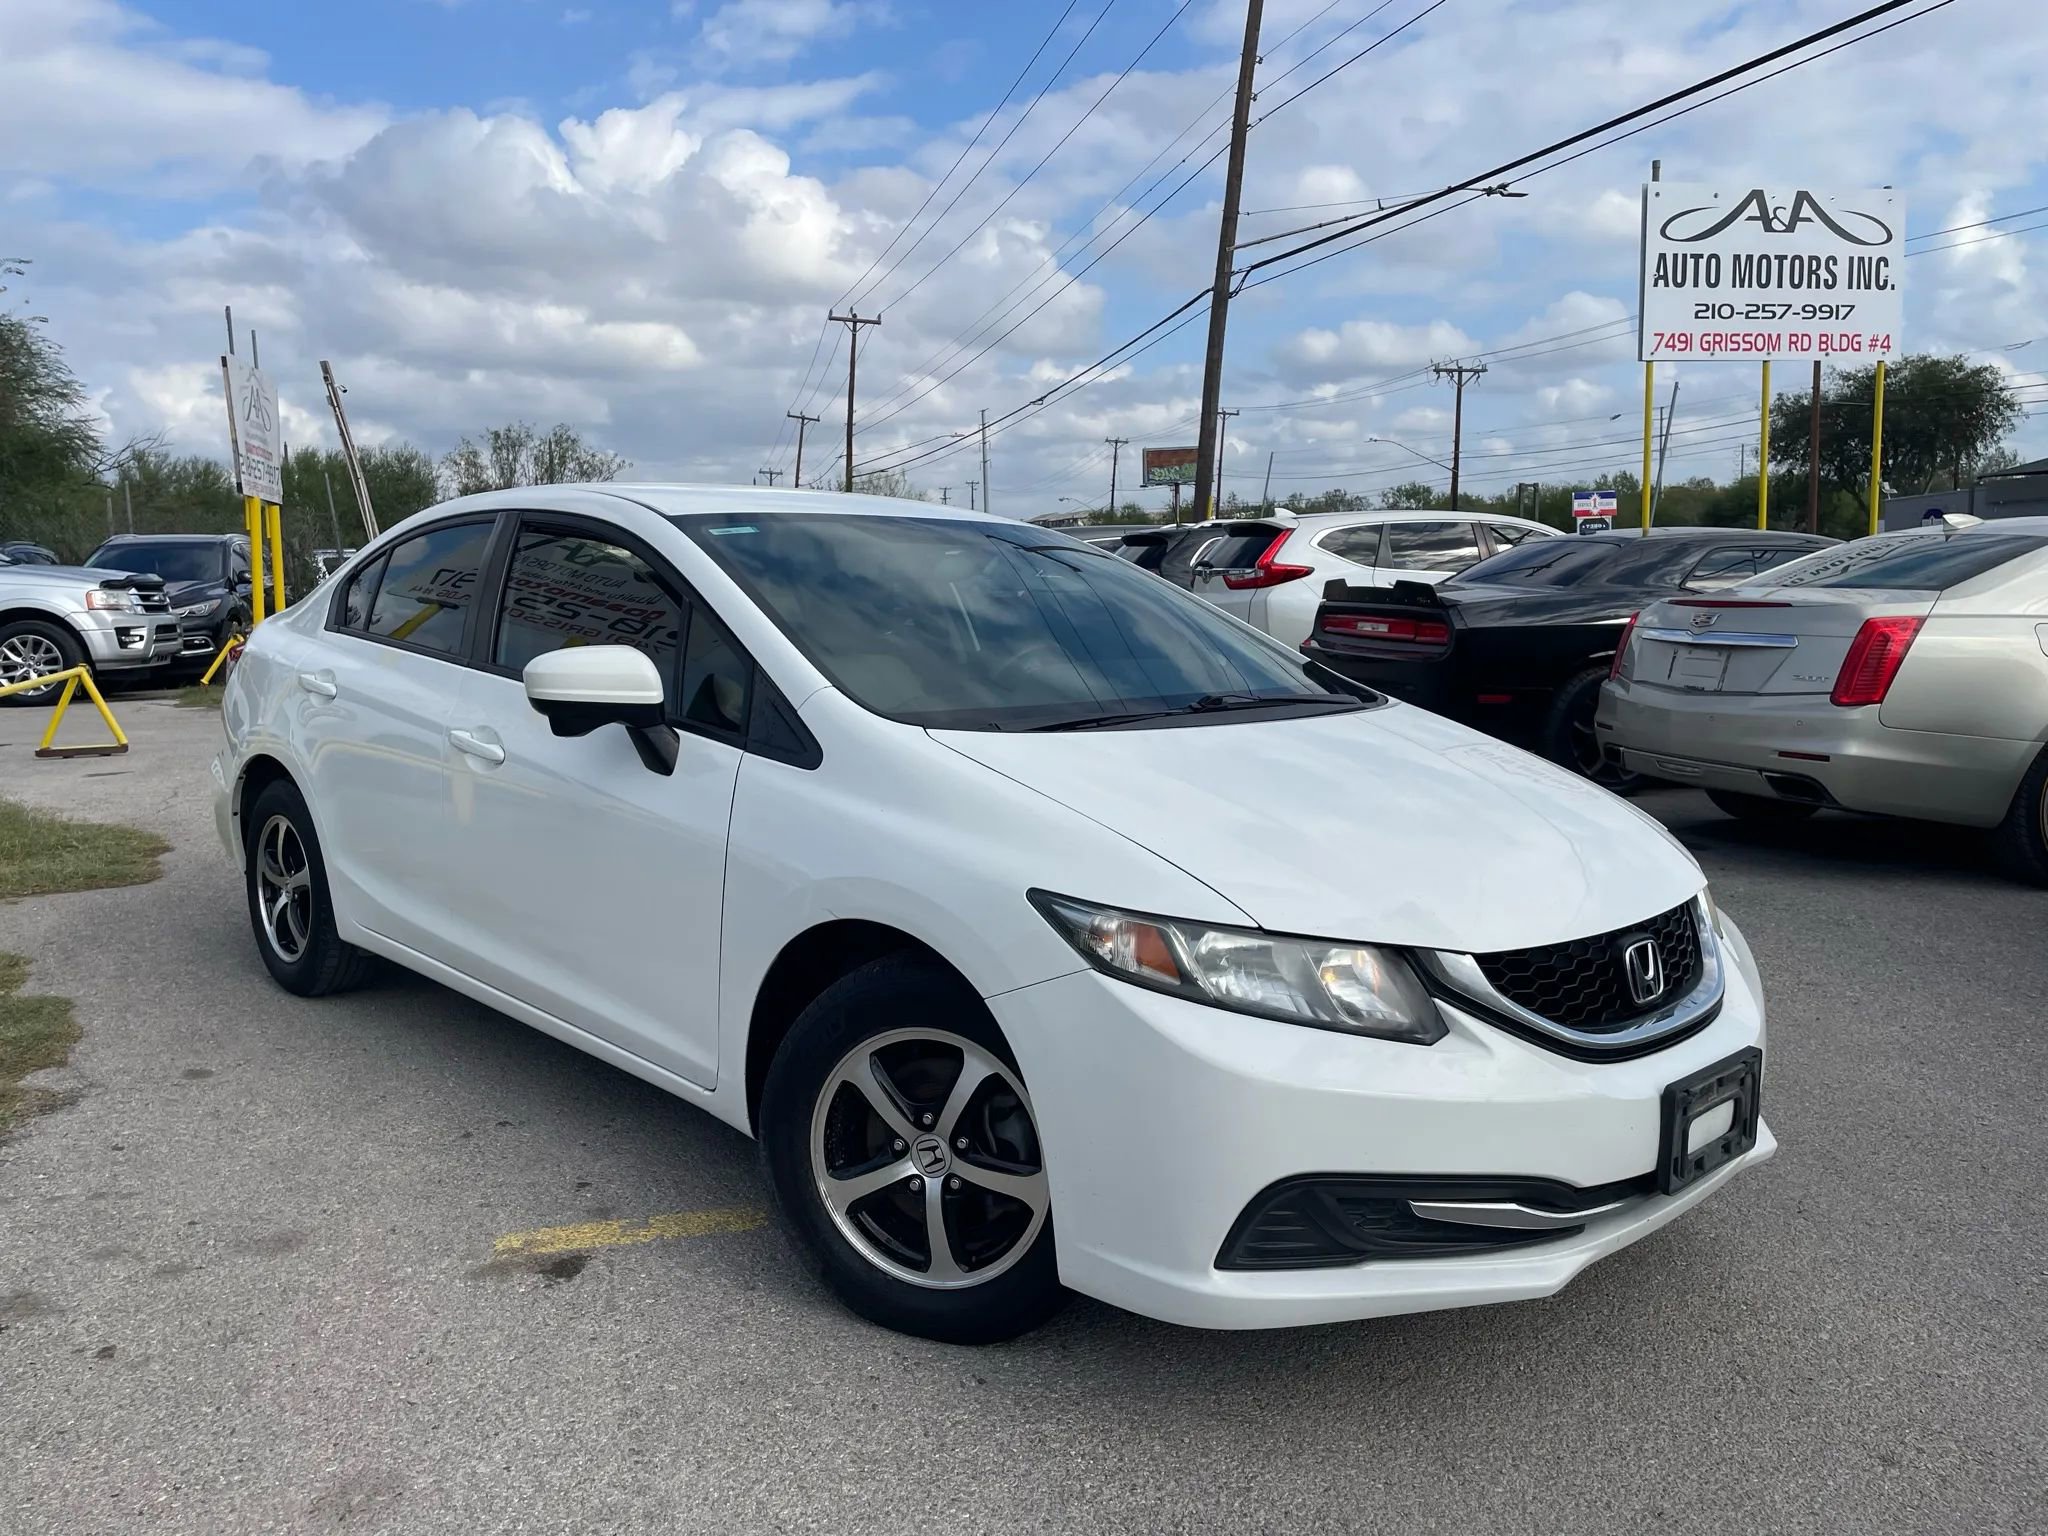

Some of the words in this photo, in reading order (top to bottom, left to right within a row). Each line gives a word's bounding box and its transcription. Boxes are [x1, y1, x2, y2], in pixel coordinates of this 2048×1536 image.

[1653, 253, 1721, 288] AUTO
[1731, 254, 1838, 290] MOTORS
[1847, 255, 1896, 291] INC.
[1693, 303, 1856, 321] 210-257-9917
[1653, 333, 1693, 352] 7491
[1699, 333, 1782, 352] GRISSOM
[1788, 333, 1812, 352] RD
[1818, 333, 1862, 353] BLDG
[1868, 334, 1891, 353] #4
